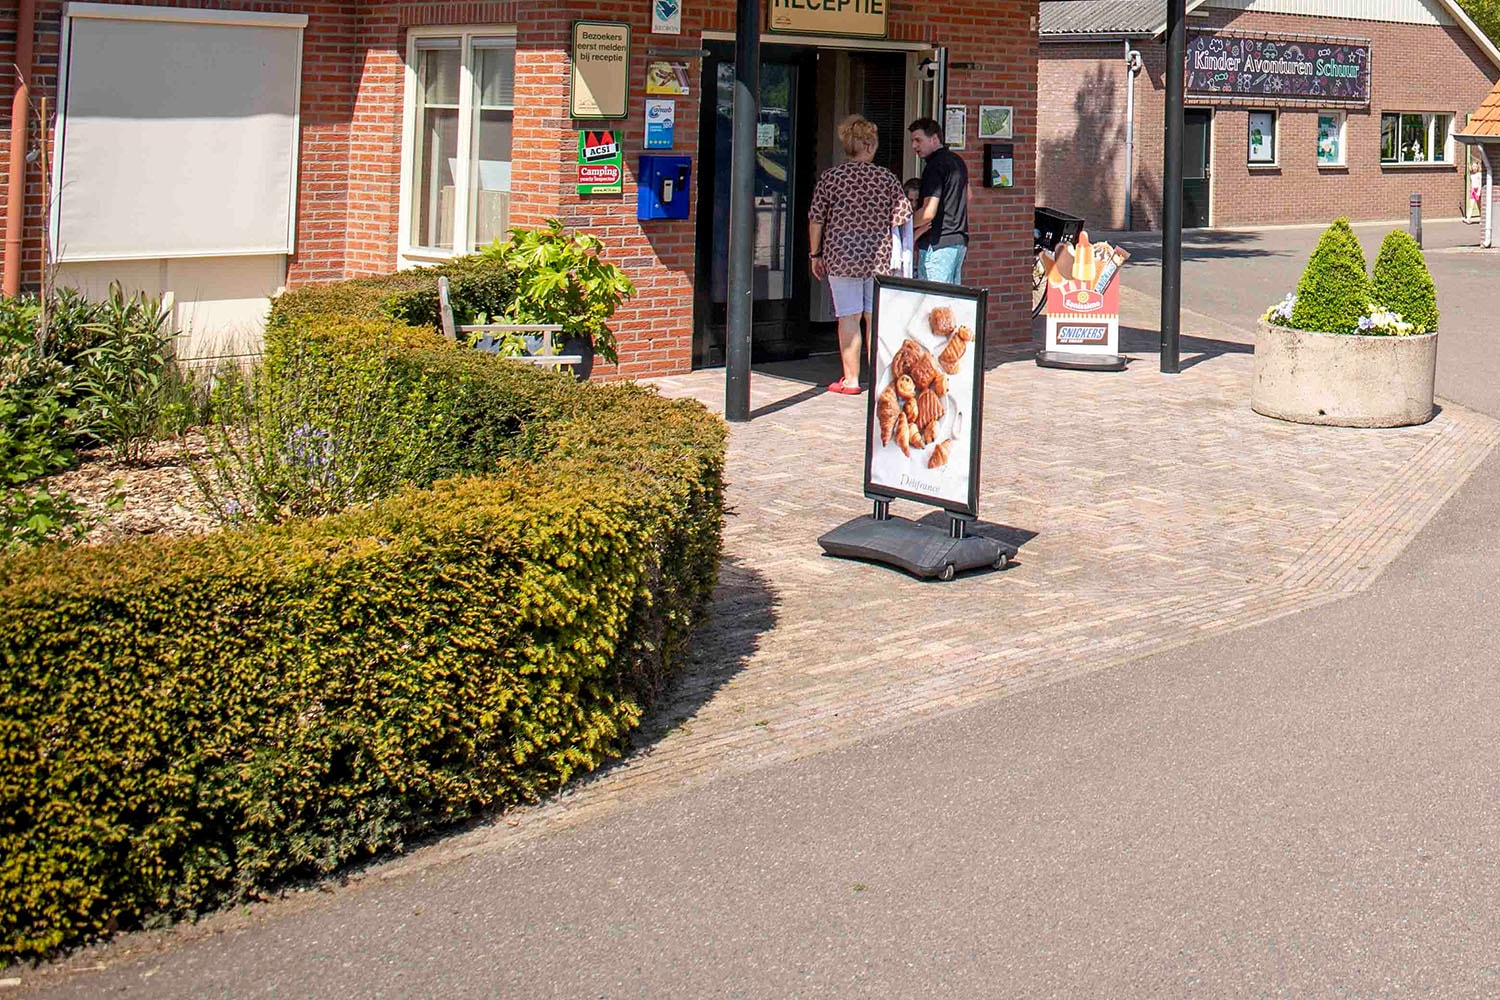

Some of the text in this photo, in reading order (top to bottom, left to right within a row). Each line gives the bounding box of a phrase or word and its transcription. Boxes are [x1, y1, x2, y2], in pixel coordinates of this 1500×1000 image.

[582, 31, 623, 41] Bezoekers
[577, 43, 626, 52] eerst melden
[580, 53, 623, 63] bij receptie
[1194, 51, 1359, 78] Kinder Avonturen Schuur
[590, 146, 610, 155] ACSI
[581, 166, 617, 176] Camping
[1060, 327, 1104, 338] SNICKERS
